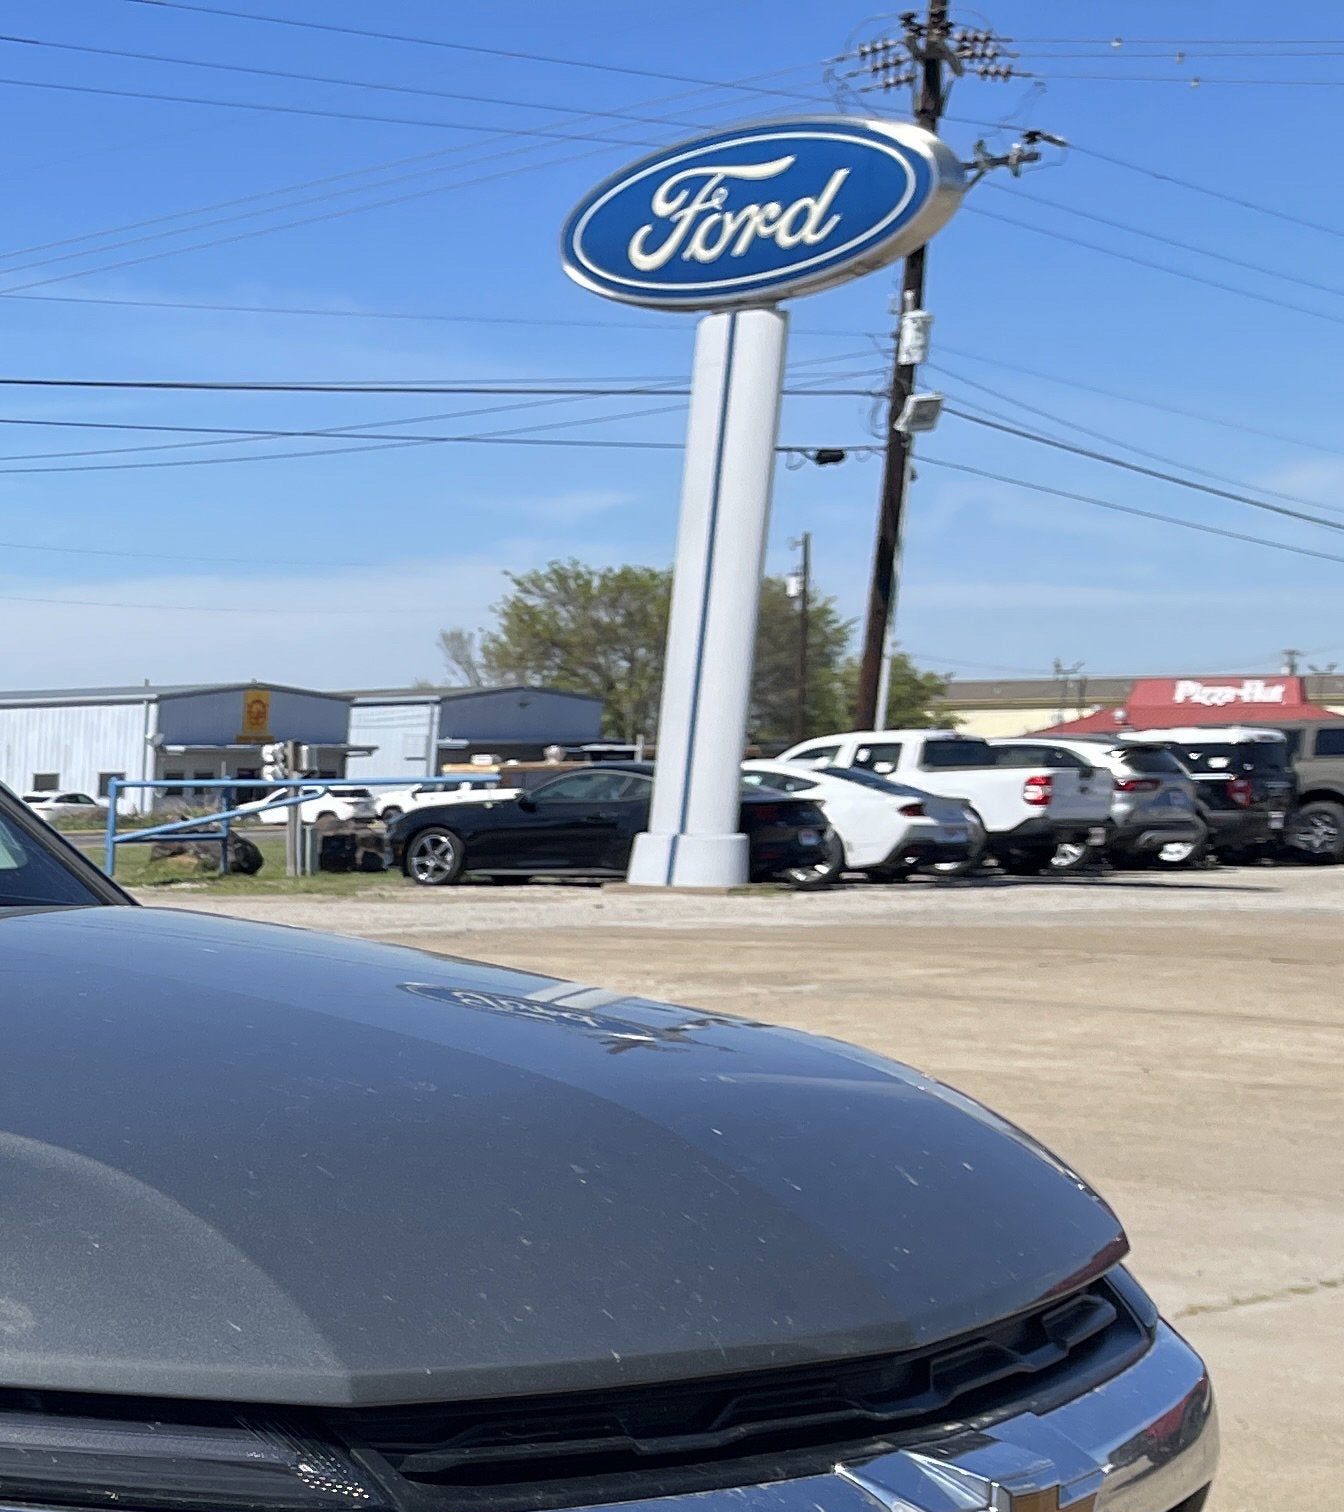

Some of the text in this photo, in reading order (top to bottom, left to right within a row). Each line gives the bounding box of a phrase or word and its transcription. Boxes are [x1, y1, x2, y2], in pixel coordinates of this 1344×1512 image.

[628, 155, 852, 271] Ford
[1174, 680, 1286, 706] Pizza Hut
